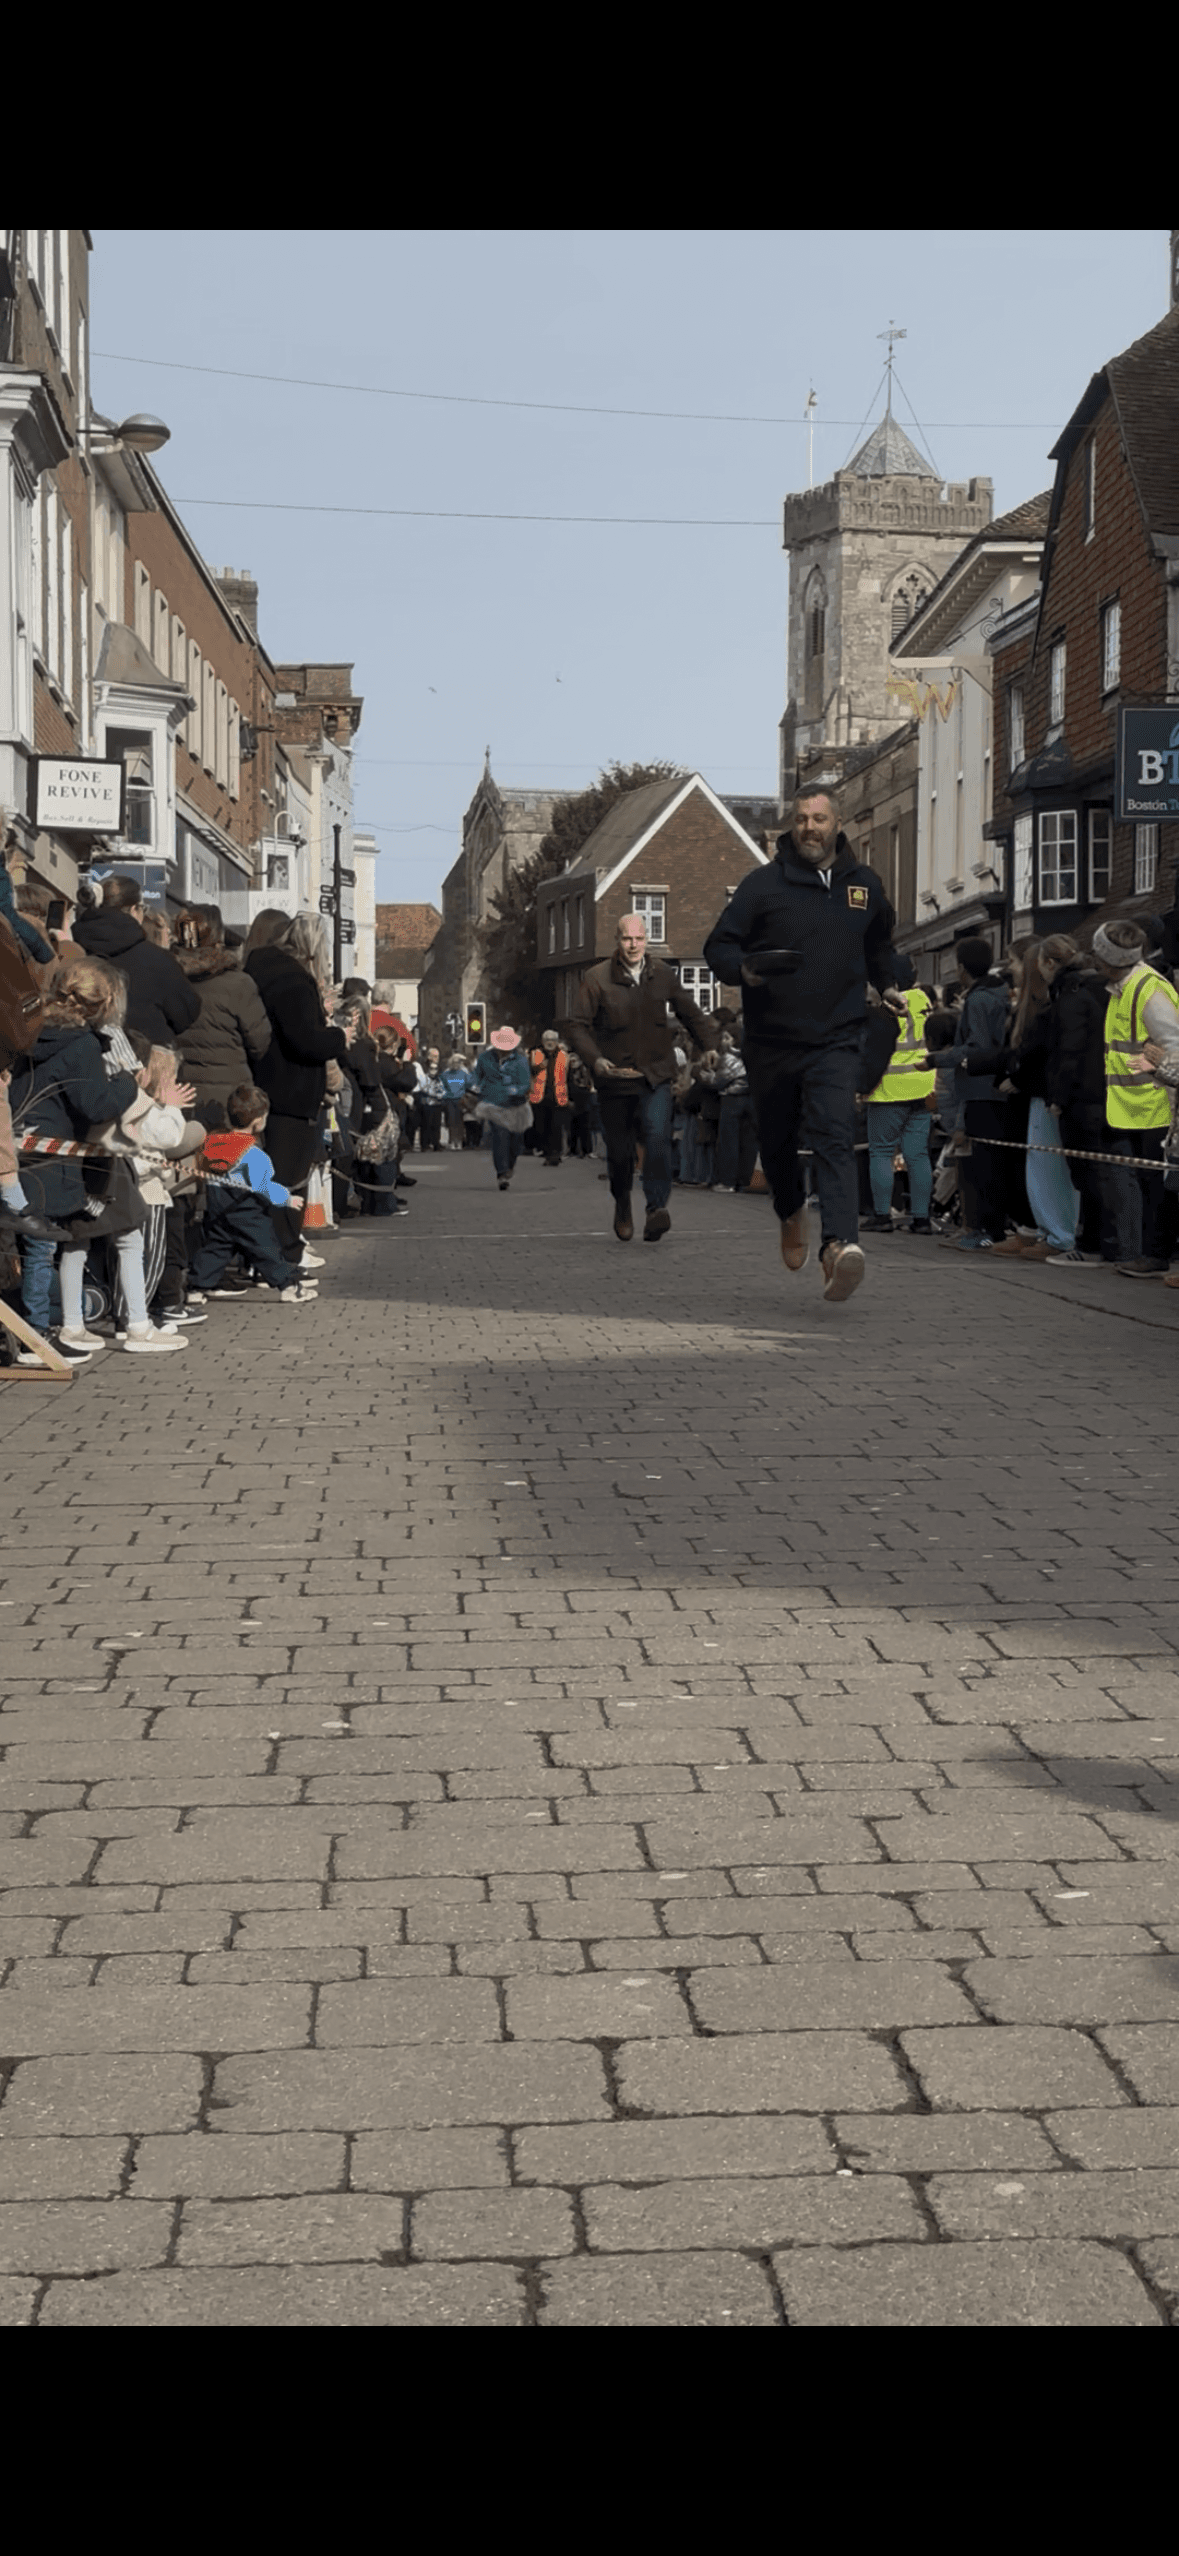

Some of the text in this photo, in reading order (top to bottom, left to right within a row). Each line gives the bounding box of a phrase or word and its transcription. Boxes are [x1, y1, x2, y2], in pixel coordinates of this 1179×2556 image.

[59, 769, 102, 784] FONE
[47, 785, 113, 801] REVIVE
[1127, 799, 1167, 810] Boston
